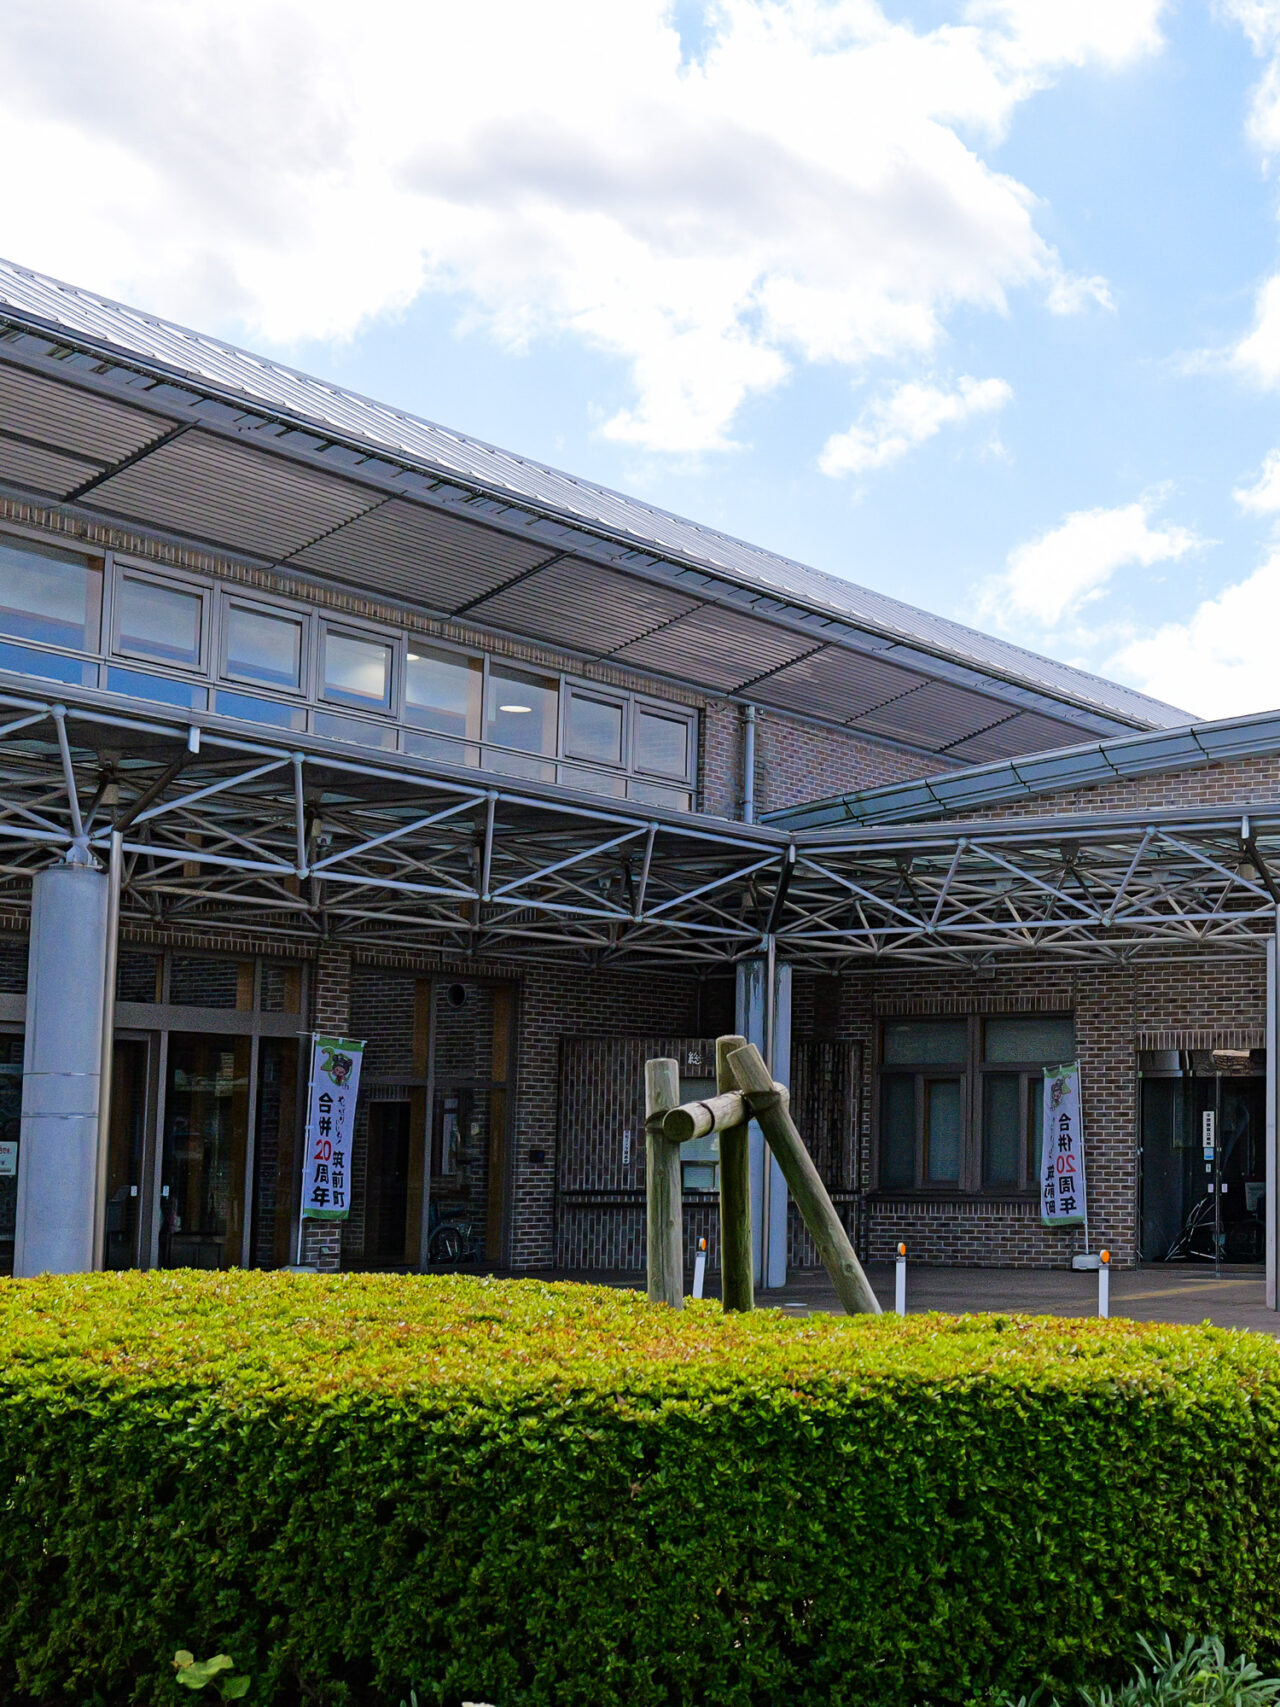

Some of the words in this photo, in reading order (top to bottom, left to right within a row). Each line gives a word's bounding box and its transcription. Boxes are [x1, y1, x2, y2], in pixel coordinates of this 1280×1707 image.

[311, 1092, 334, 1207] 合併20周年
[331, 1151, 345, 1208] 筑前町
